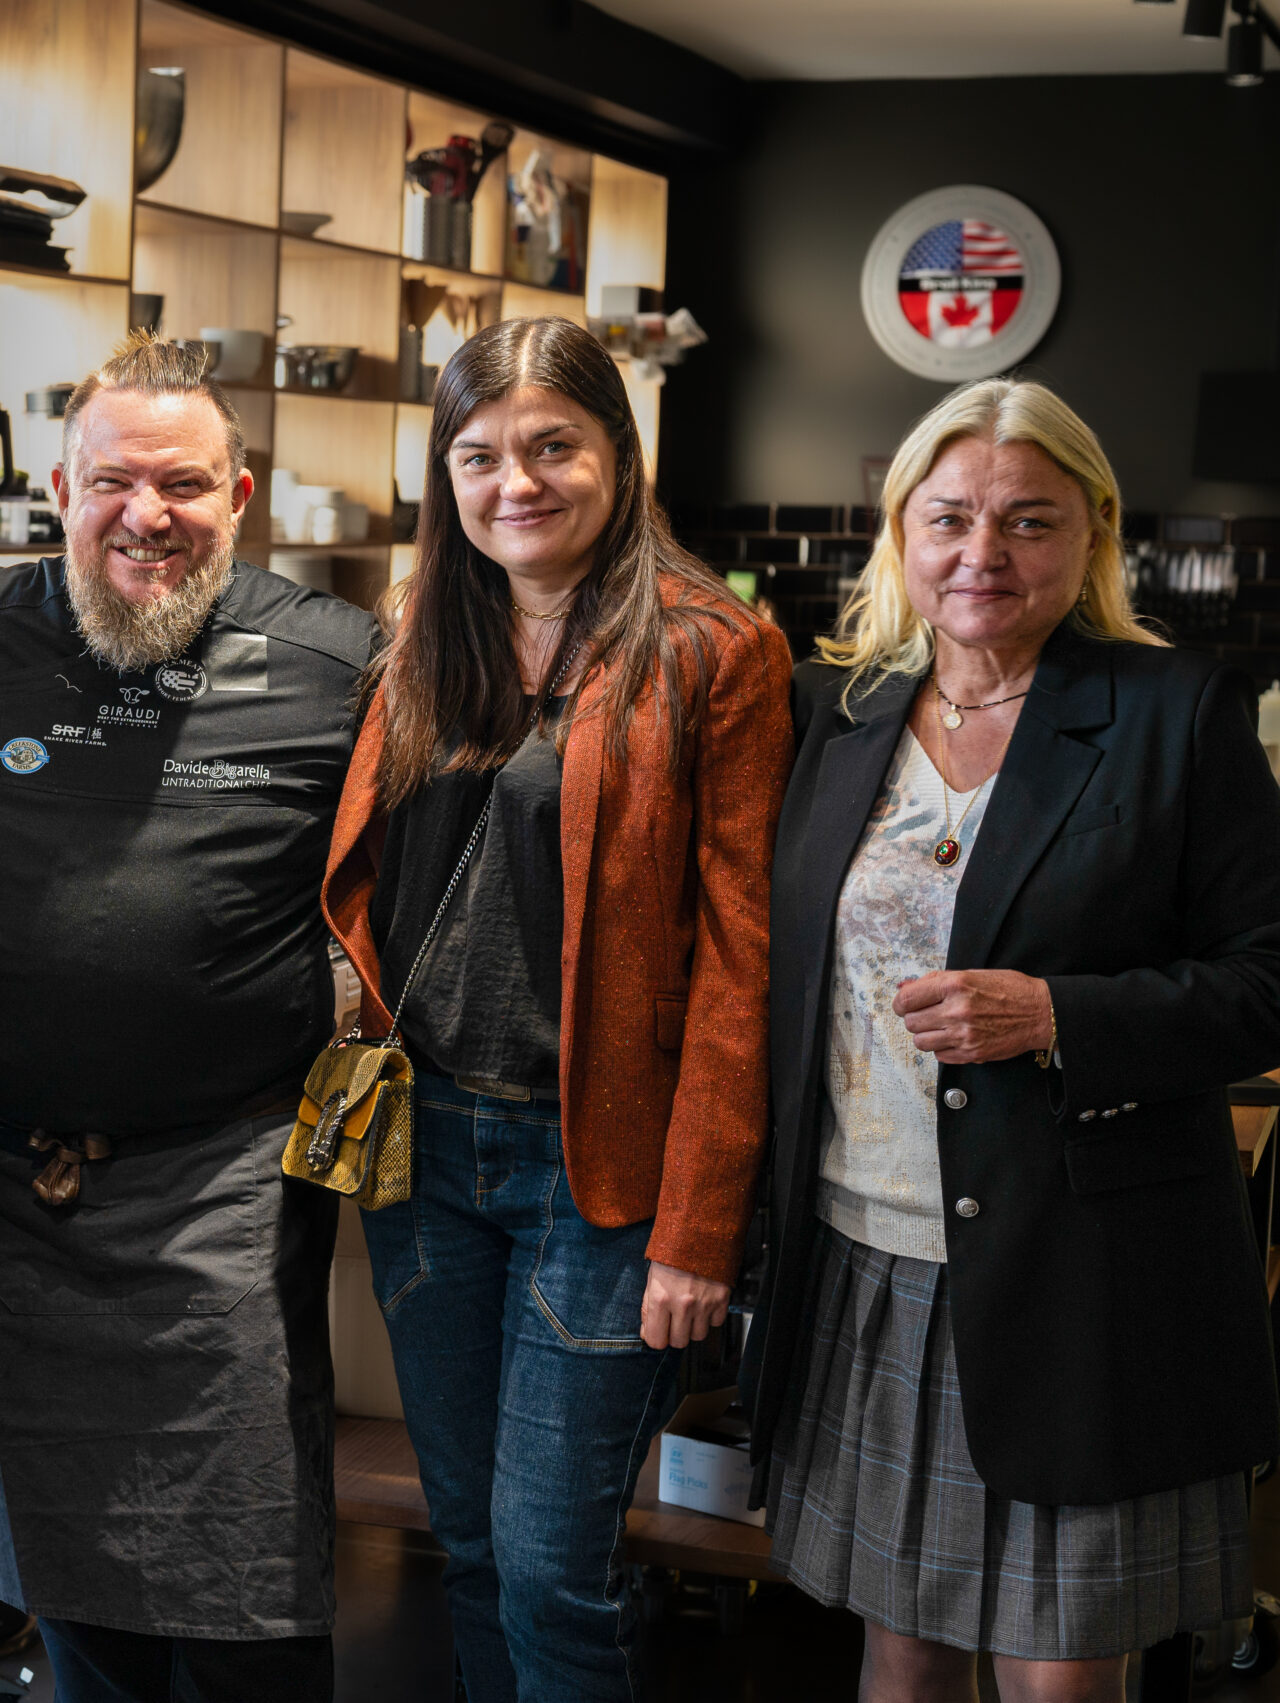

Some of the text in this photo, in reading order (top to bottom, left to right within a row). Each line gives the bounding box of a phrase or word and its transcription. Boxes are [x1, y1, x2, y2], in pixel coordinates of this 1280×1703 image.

[99, 705, 160, 720] GIRAUDI
[52, 724, 86, 737] SRF
[163, 759, 270, 780] Davide Bigarella
